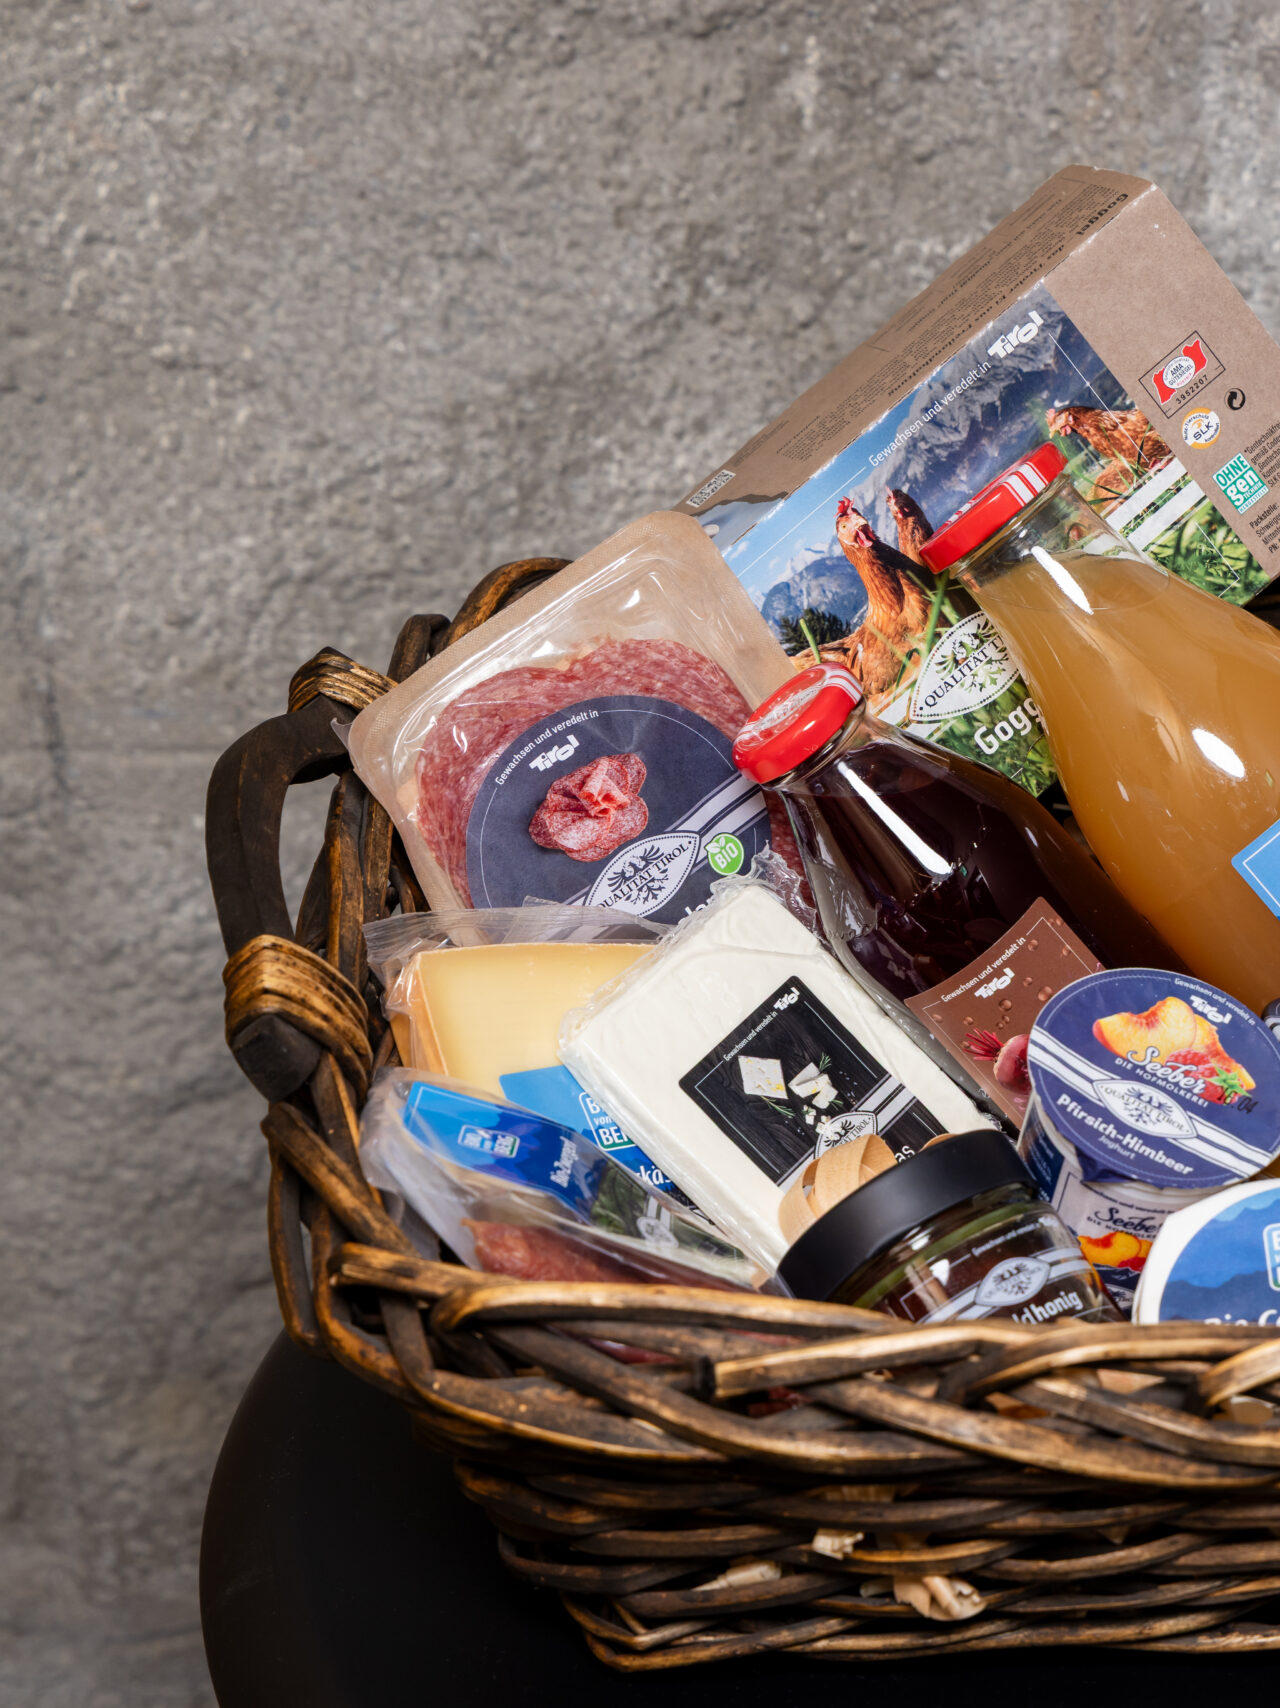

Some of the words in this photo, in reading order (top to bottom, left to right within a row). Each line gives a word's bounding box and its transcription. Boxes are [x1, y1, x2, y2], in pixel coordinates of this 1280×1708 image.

[1171, 363, 1184, 376] AMA
[868, 419, 925, 467] Gewachsen
[921, 400, 943, 423] und
[942, 369, 980, 406] veredelt
[978, 361, 991, 374] in
[987, 310, 1044, 359] Tirol
[1175, 374, 1208, 405] 3952207
[1193, 421, 1214, 441] SLK
[1215, 455, 1248, 487] OHNE
[1268, 475, 1279, 488] SLK
[1226, 469, 1260, 506] gen
[1243, 480, 1263, 500] TECHNIK
[1249, 502, 1280, 530] Packstelle:
[924, 645, 990, 708] QUALITÄT
[495, 742, 535, 785] Gewachsen
[534, 727, 553, 745] und
[551, 711, 590, 734] veredelt
[588, 709, 599, 721] in
[529, 734, 580, 772] Tirol
[653, 843, 689, 874] TIROL
[714, 842, 739, 870] BIO
[941, 975, 981, 1003] Gewachsen
[978, 964, 994, 980] und
[992, 942, 1020, 969] veredelt
[1016, 936, 1027, 946] in
[974, 967, 1016, 999] Tirol
[773, 987, 800, 1011] Tirol
[1174, 977, 1213, 999] Gewachsen
[1211, 992, 1228, 1007] und
[1224, 999, 1250, 1022] veredelt
[1246, 1016, 1256, 1026] in
[1190, 994, 1232, 1025] Tirol
[754, 1014, 774, 1033] veredelt
[770, 1010, 778, 1020] in
[723, 1036, 749, 1062] Gewachsen
[746, 1028, 757, 1042] und
[1115, 1056, 1134, 1071] DIE
[1135, 1066, 1209, 1109] HOFMOLKEREI
[1126, 1046, 1207, 1095] Seeber
[1104, 1085, 1157, 1117] QUALITÄT
[1155, 1112, 1186, 1133] TIROL
[598, 1126, 629, 1146] BE
[851, 1118, 871, 1138] TIROL
[1057, 1093, 1193, 1176] Pfirsich-Himbeer
[1097, 1134, 1137, 1161] Joghurt
[1094, 1207, 1162, 1234] Seebe
